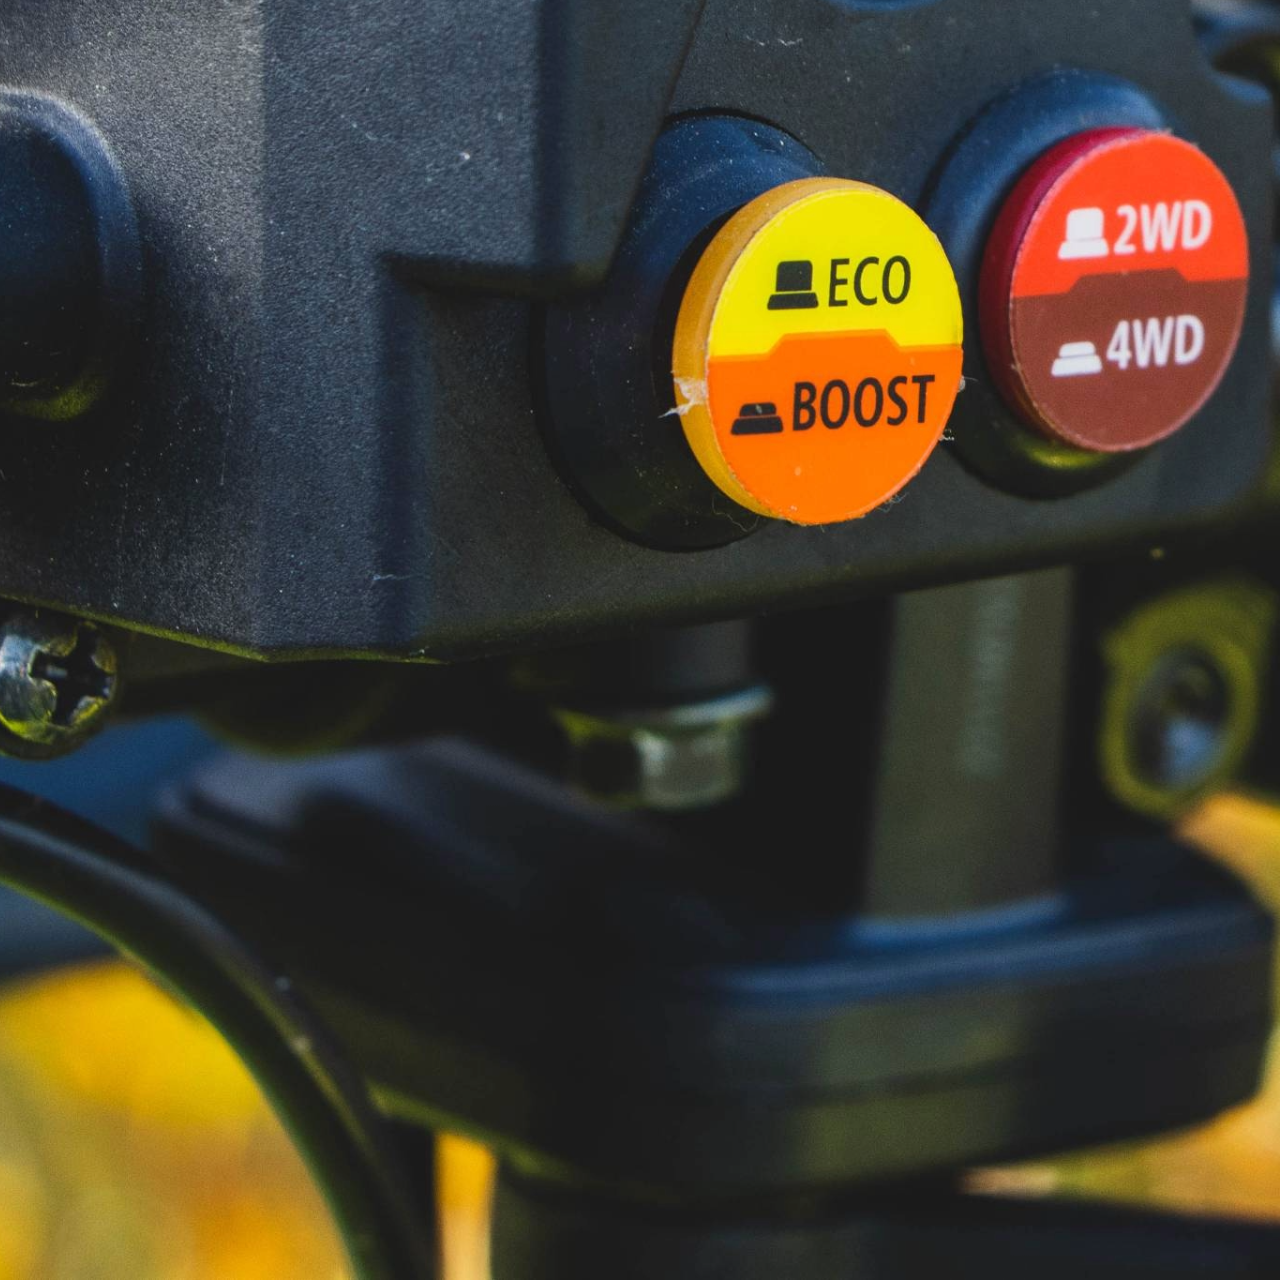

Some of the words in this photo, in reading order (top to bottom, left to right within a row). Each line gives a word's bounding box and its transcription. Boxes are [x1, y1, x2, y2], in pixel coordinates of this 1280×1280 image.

[1113, 199, 1213, 255] 2WD
[827, 255, 912, 307] ECO
[1105, 314, 1206, 370] 4WD
[791, 374, 936, 432] BOOST
